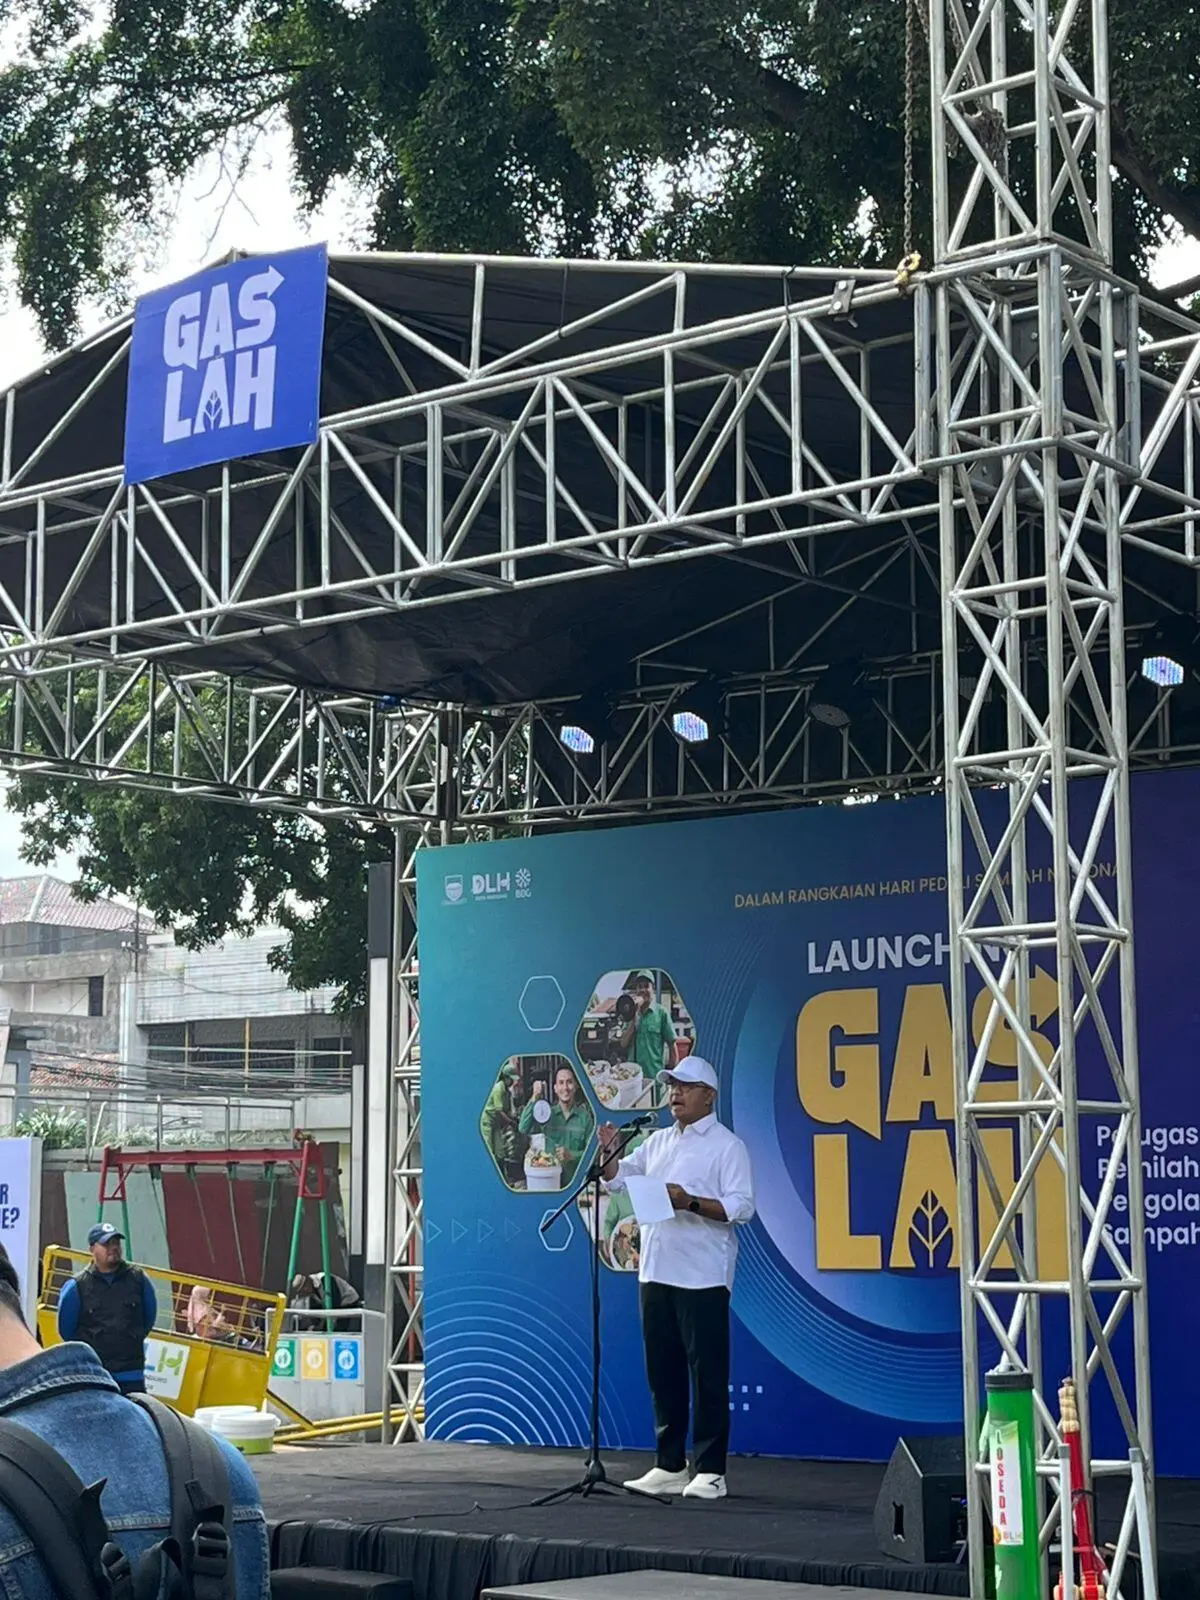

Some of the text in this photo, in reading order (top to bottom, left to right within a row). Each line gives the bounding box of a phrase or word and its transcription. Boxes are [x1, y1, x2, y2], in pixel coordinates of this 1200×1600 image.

[163, 265, 285, 371] GAS
[163, 345, 277, 444] LAH
[734, 891, 784, 909] DALAM
[788, 883, 876, 904] RANGKAIAN
[880, 879, 915, 896] HARI
[919, 875, 970, 893] PEDI
[795, 963, 1060, 1141] GAS
[1096, 1125, 1199, 1153] Pugas
[0, 1207, 20, 1230] E?
[812, 1126, 1071, 1279] LAH
